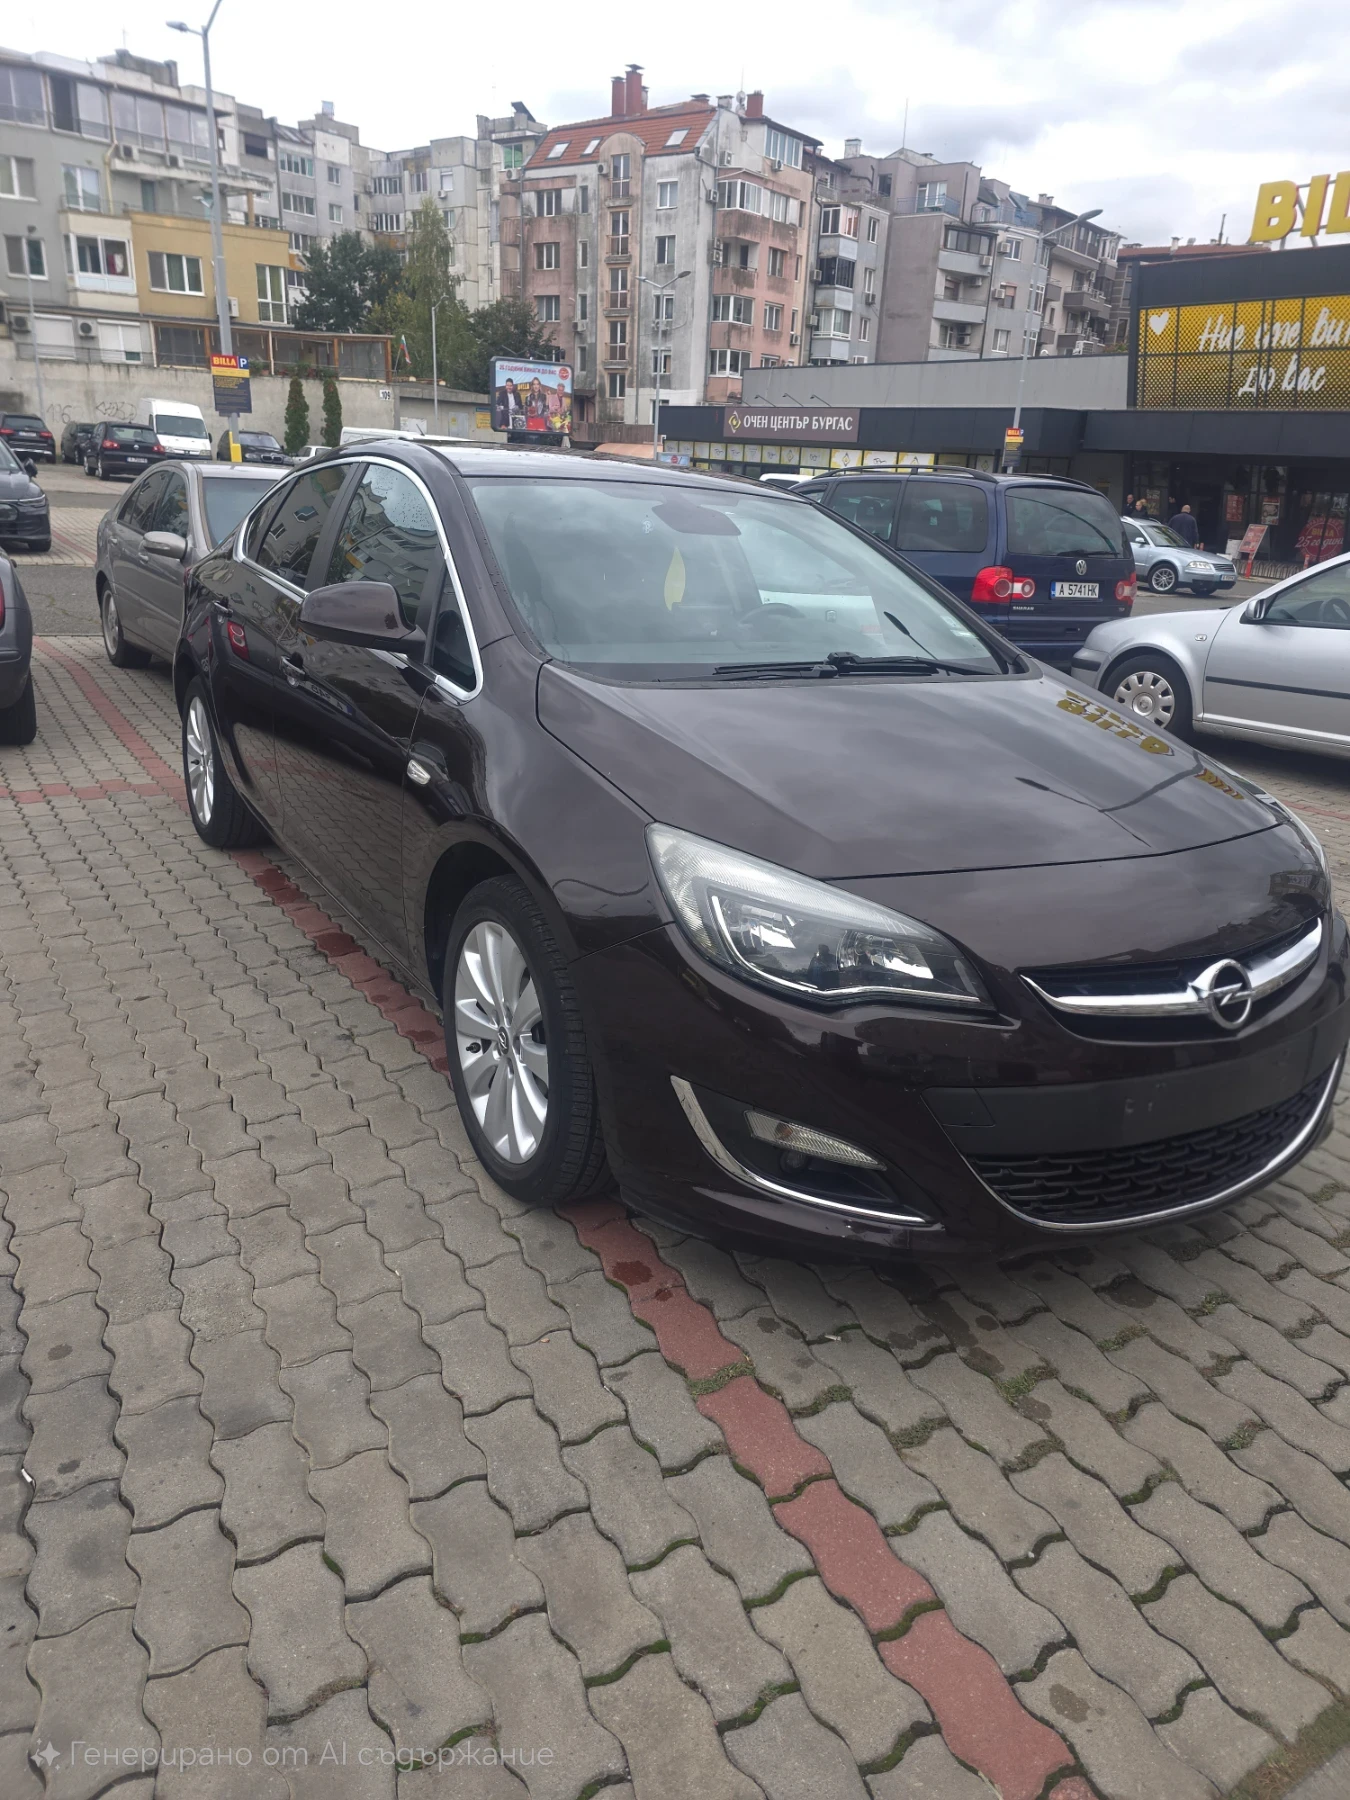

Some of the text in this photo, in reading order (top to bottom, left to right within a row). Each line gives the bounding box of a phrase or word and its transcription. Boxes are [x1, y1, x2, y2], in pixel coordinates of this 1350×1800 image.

[1197, 314, 1246, 352] Ние
[213, 356, 247, 368] BILLA P
[743, 415, 853, 431] ОЧЕН ЦЕНТЪР БУРГАС
